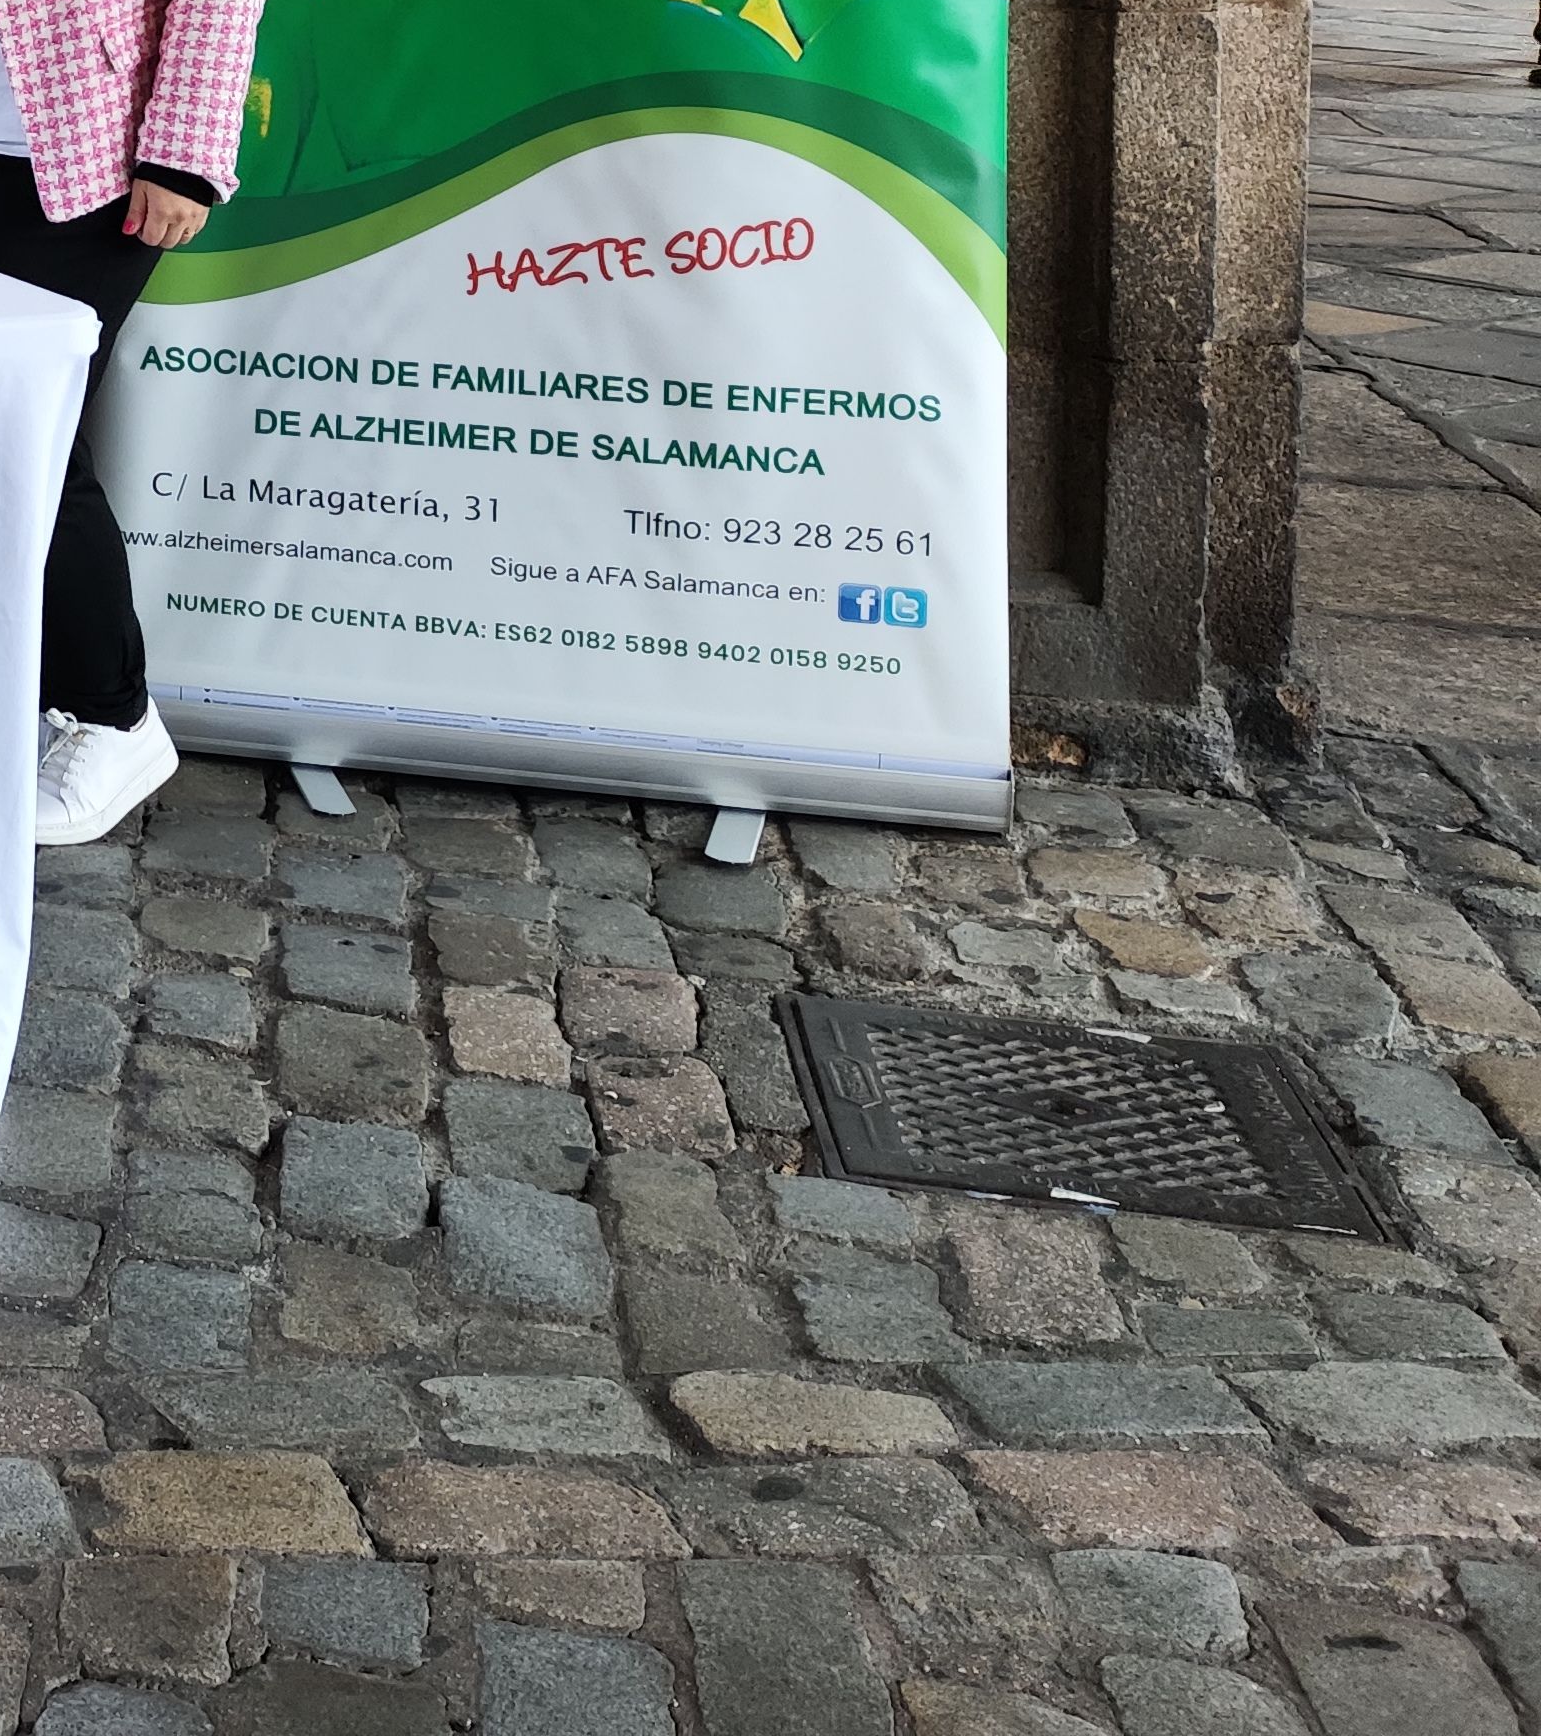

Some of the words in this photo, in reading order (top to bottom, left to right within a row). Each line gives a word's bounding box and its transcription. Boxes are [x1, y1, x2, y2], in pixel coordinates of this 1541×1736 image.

[464, 234, 655, 298] HAZTE
[664, 216, 815, 274] SOCIO
[139, 344, 360, 385] ASOCIACION
[370, 358, 420, 389] DE
[431, 363, 650, 405] FAMILIARES
[662, 379, 714, 410] DE
[726, 384, 943, 423] ENFERMOS
[254, 408, 301, 438] DE
[310, 412, 518, 454] ALZHEIMER
[529, 428, 580, 459] DE
[591, 433, 826, 476] SALAMANCA
[151, 472, 188, 502] C/
[202, 474, 236, 502] La
[249, 477, 450, 524] Maragatería,
[463, 494, 500, 523] 31
[722, 517, 782, 546] 923
[793, 521, 833, 550] 28
[845, 526, 884, 554] 25
[896, 530, 933, 558] 61
[490, 556, 558, 583] Sigue
[565, 567, 580, 584] a
[586, 564, 638, 589] AFA
[644, 569, 780, 601] Salamanca
[789, 586, 827, 603] en:
[166, 592, 266, 619] NUMERO
[274, 602, 304, 622] DE
[311, 604, 407, 632] CUENTA
[415, 615, 488, 640] BBVA:
[494, 622, 554, 646] ES62
[560, 628, 617, 652] 0182
[624, 634, 689, 658] 5898
[697, 641, 762, 665] 9402
[769, 646, 828, 670] 0158
[836, 652, 903, 676] 9250
